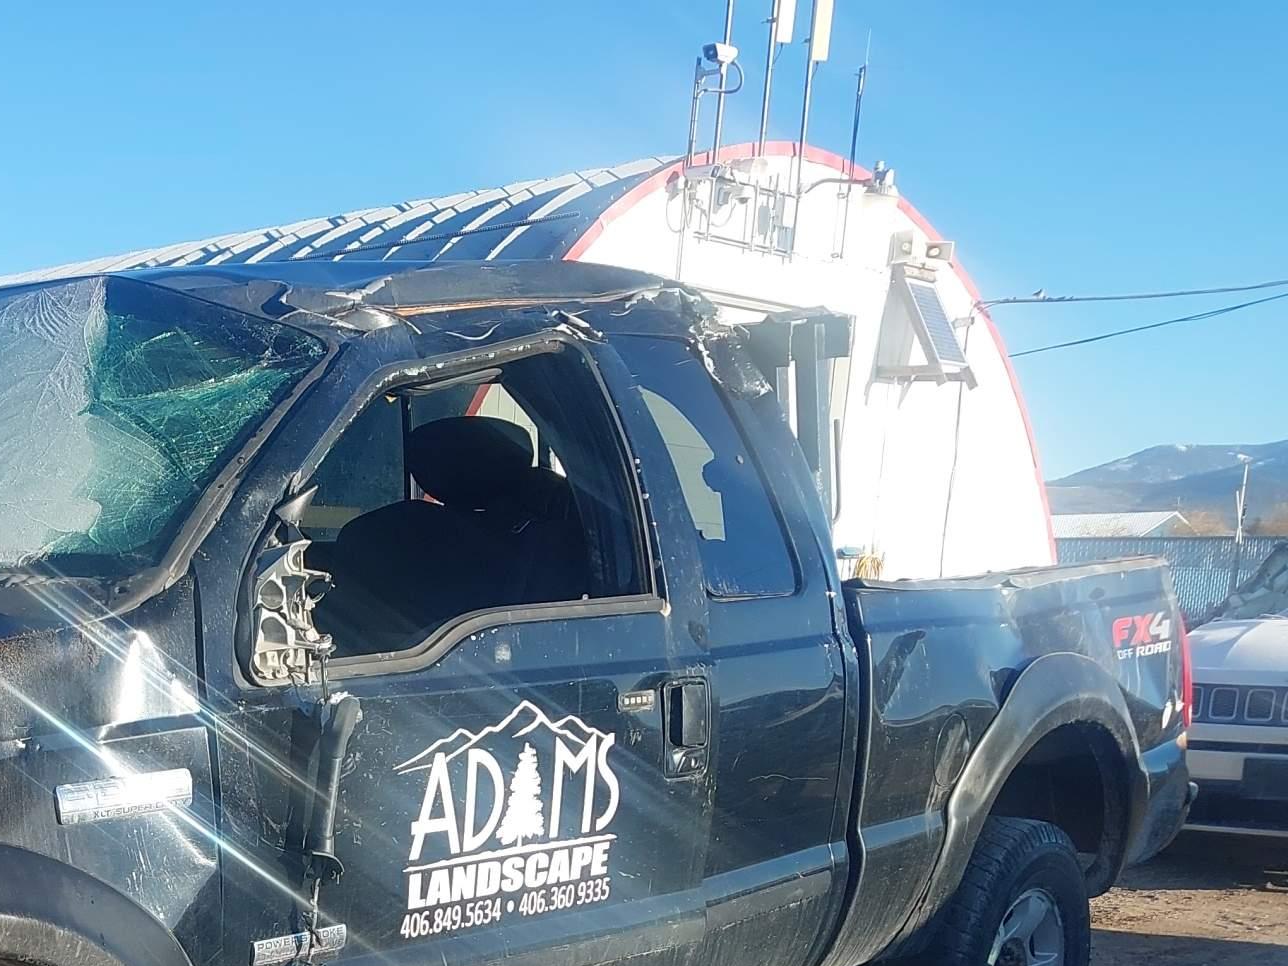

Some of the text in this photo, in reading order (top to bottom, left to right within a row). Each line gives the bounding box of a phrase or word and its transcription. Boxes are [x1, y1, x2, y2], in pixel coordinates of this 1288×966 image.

[1113, 611, 1170, 648] FX4
[1116, 640, 1172, 660] OFF ROAD
[115, 803, 152, 815] SUPER
[408, 842, 610, 909] LANDSCAPE
[400, 900, 502, 939] 406.849.5634
